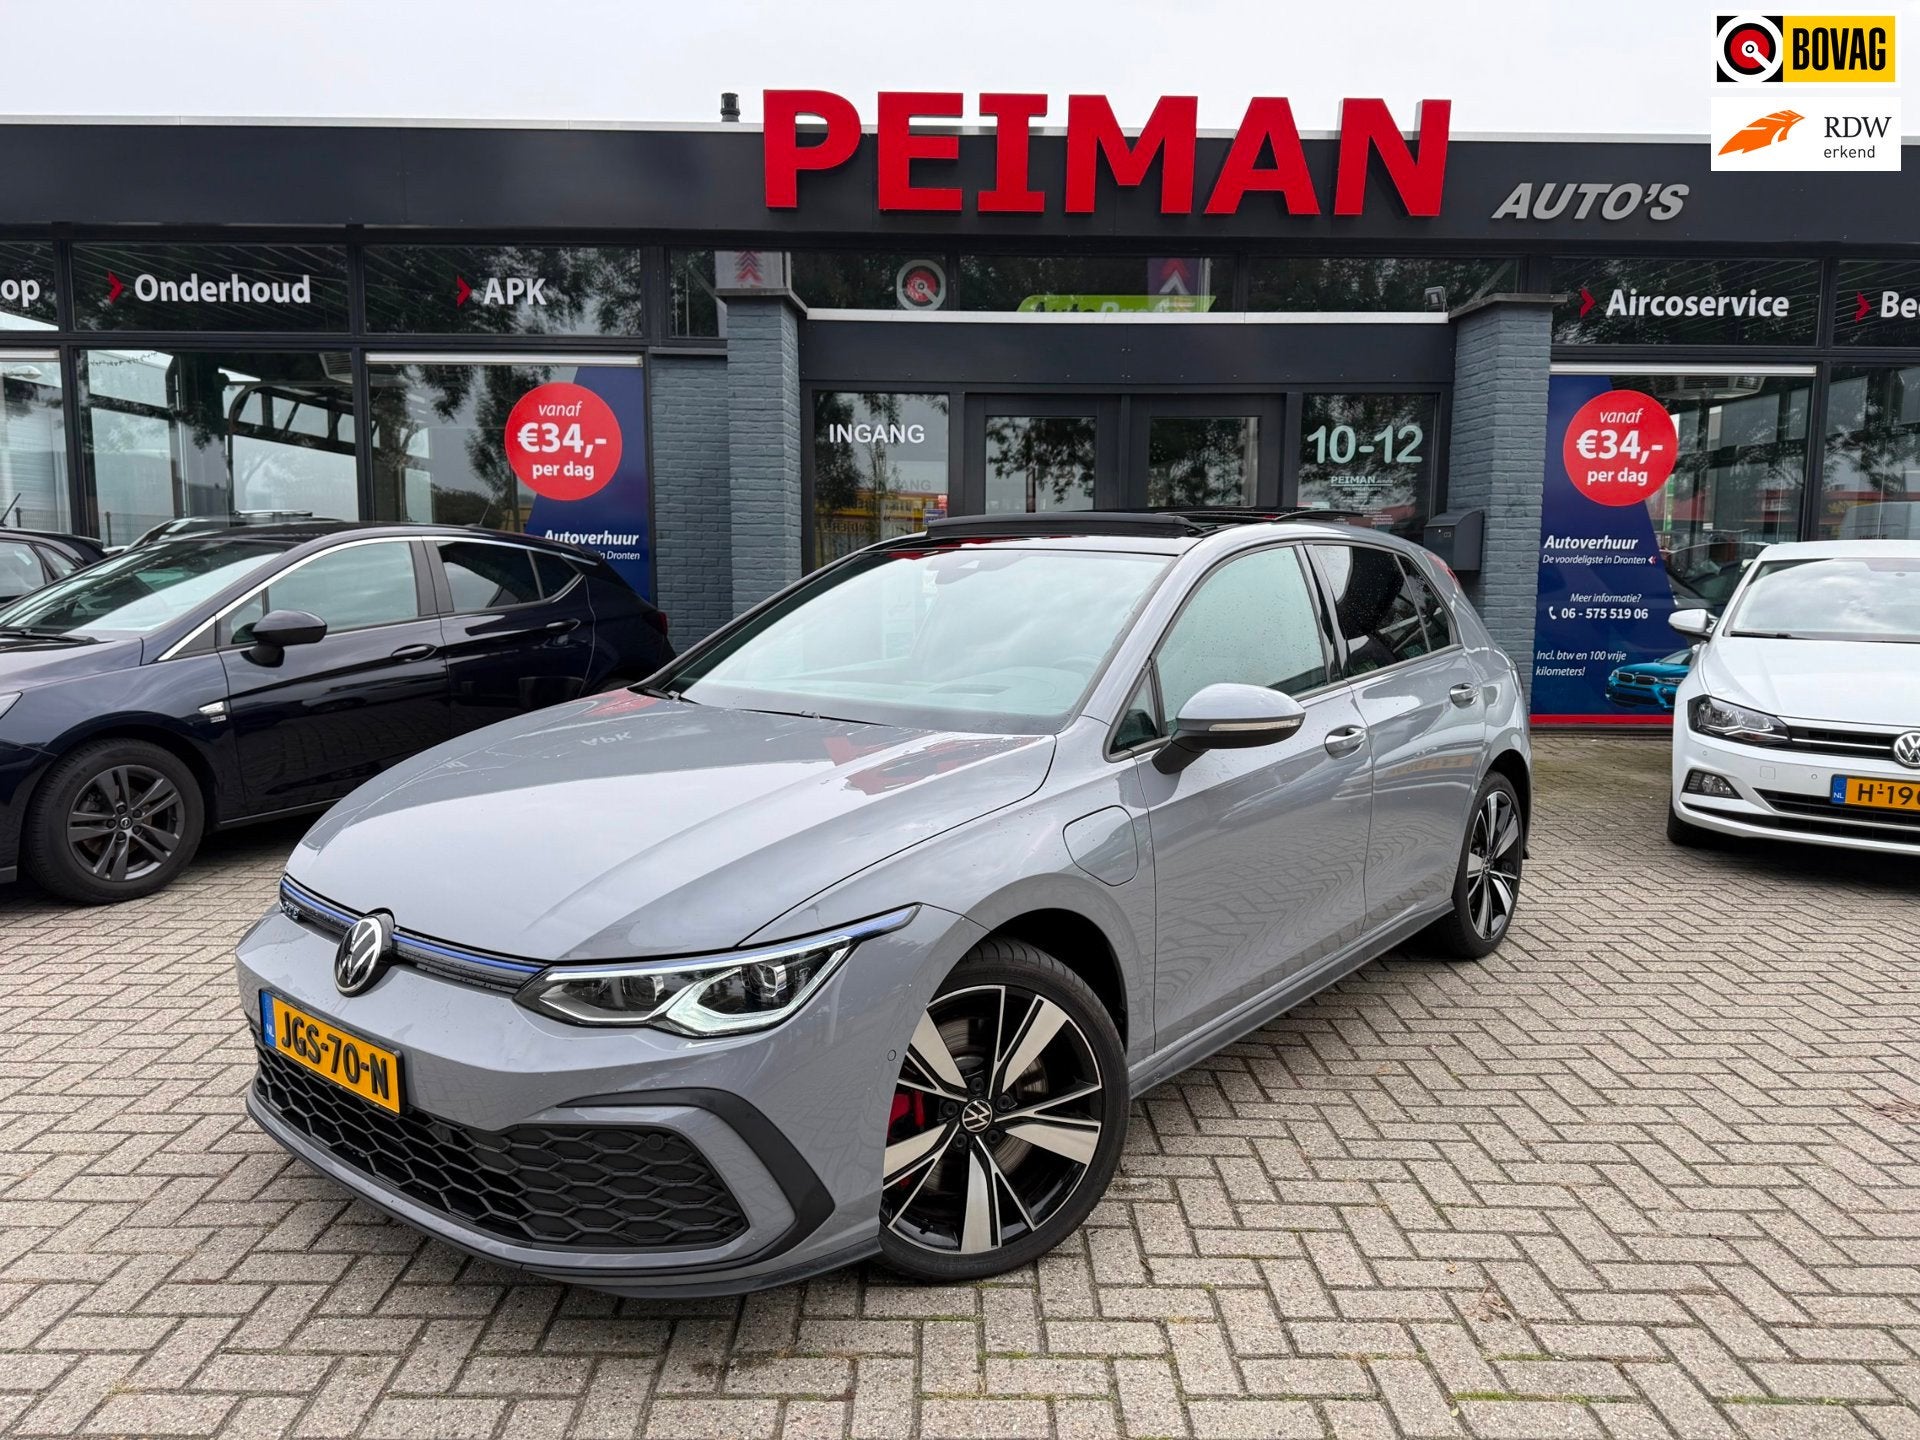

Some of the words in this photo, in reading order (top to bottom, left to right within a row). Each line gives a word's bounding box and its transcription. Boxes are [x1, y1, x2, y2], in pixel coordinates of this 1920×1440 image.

[763, 89, 1451, 217] PEIMAN
[1491, 182, 1690, 221] AUTO'S
[134, 272, 311, 304] Onderhoud
[483, 277, 548, 306] APK
[1605, 288, 1790, 319] Aircoservice
[1880, 290, 1920, 319] Be
[538, 400, 583, 417] vanaf
[1599, 407, 1644, 424] vanaf
[517, 422, 607, 458] €34,-
[829, 423, 925, 444] INGANG
[1306, 425, 1424, 464] 10-12
[1576, 428, 1664, 465] €34,-
[532, 463, 560, 480] per
[563, 460, 595, 481] dag
[1330, 475, 1376, 484] PEIMAN
[1586, 470, 1615, 486] per
[1617, 467, 1648, 487] dag
[544, 529, 640, 546] Autoverhuur
[1543, 534, 1639, 550] Autoverhuur
[606, 550, 641, 560] Dronten
[1542, 554, 1554, 564] De
[1555, 554, 1603, 566] voordeligste
[1604, 555, 1612, 564] in
[1613, 555, 1647, 565] Dronten
[1570, 592, 1592, 603] Meer
[1592, 592, 1642, 603] informatie?
[1561, 607, 1576, 619] 06
[1585, 607, 1607, 619] 575
[1609, 608, 1632, 619] 519
[1633, 608, 1649, 620] 06
[1536, 650, 1554, 661] Incl.
[1556, 650, 1575, 661] btw
[1575, 651, 1587, 661] en
[1589, 650, 1607, 661] 100
[1607, 650, 1627, 663] vrije
[1535, 666, 1586, 677] kilometers!
[281, 1010, 390, 1101] JGS-70-N
